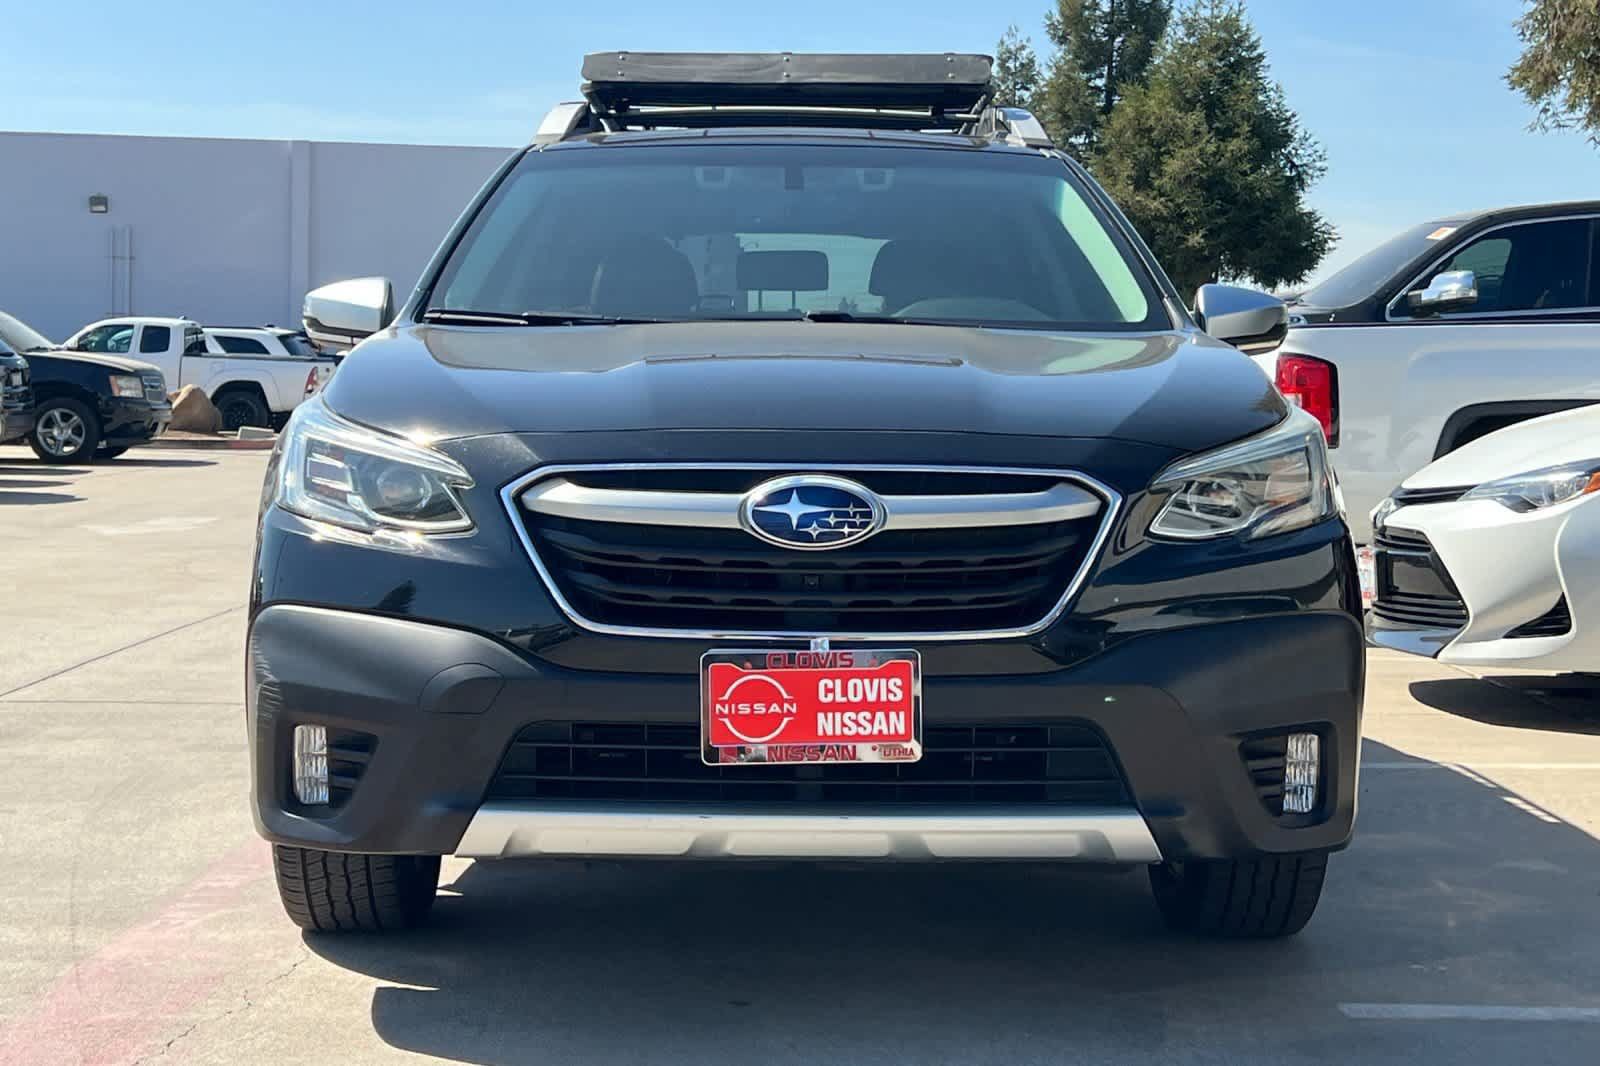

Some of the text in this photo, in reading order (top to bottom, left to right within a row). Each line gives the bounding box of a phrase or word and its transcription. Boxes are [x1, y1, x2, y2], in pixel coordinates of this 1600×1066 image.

[767, 651, 854, 668] CLOVIS
[818, 678, 903, 702] CLOVIS
[715, 703, 797, 714] NISSAN
[817, 711, 905, 736] NISSAN
[767, 745, 857, 761] NISSAN
